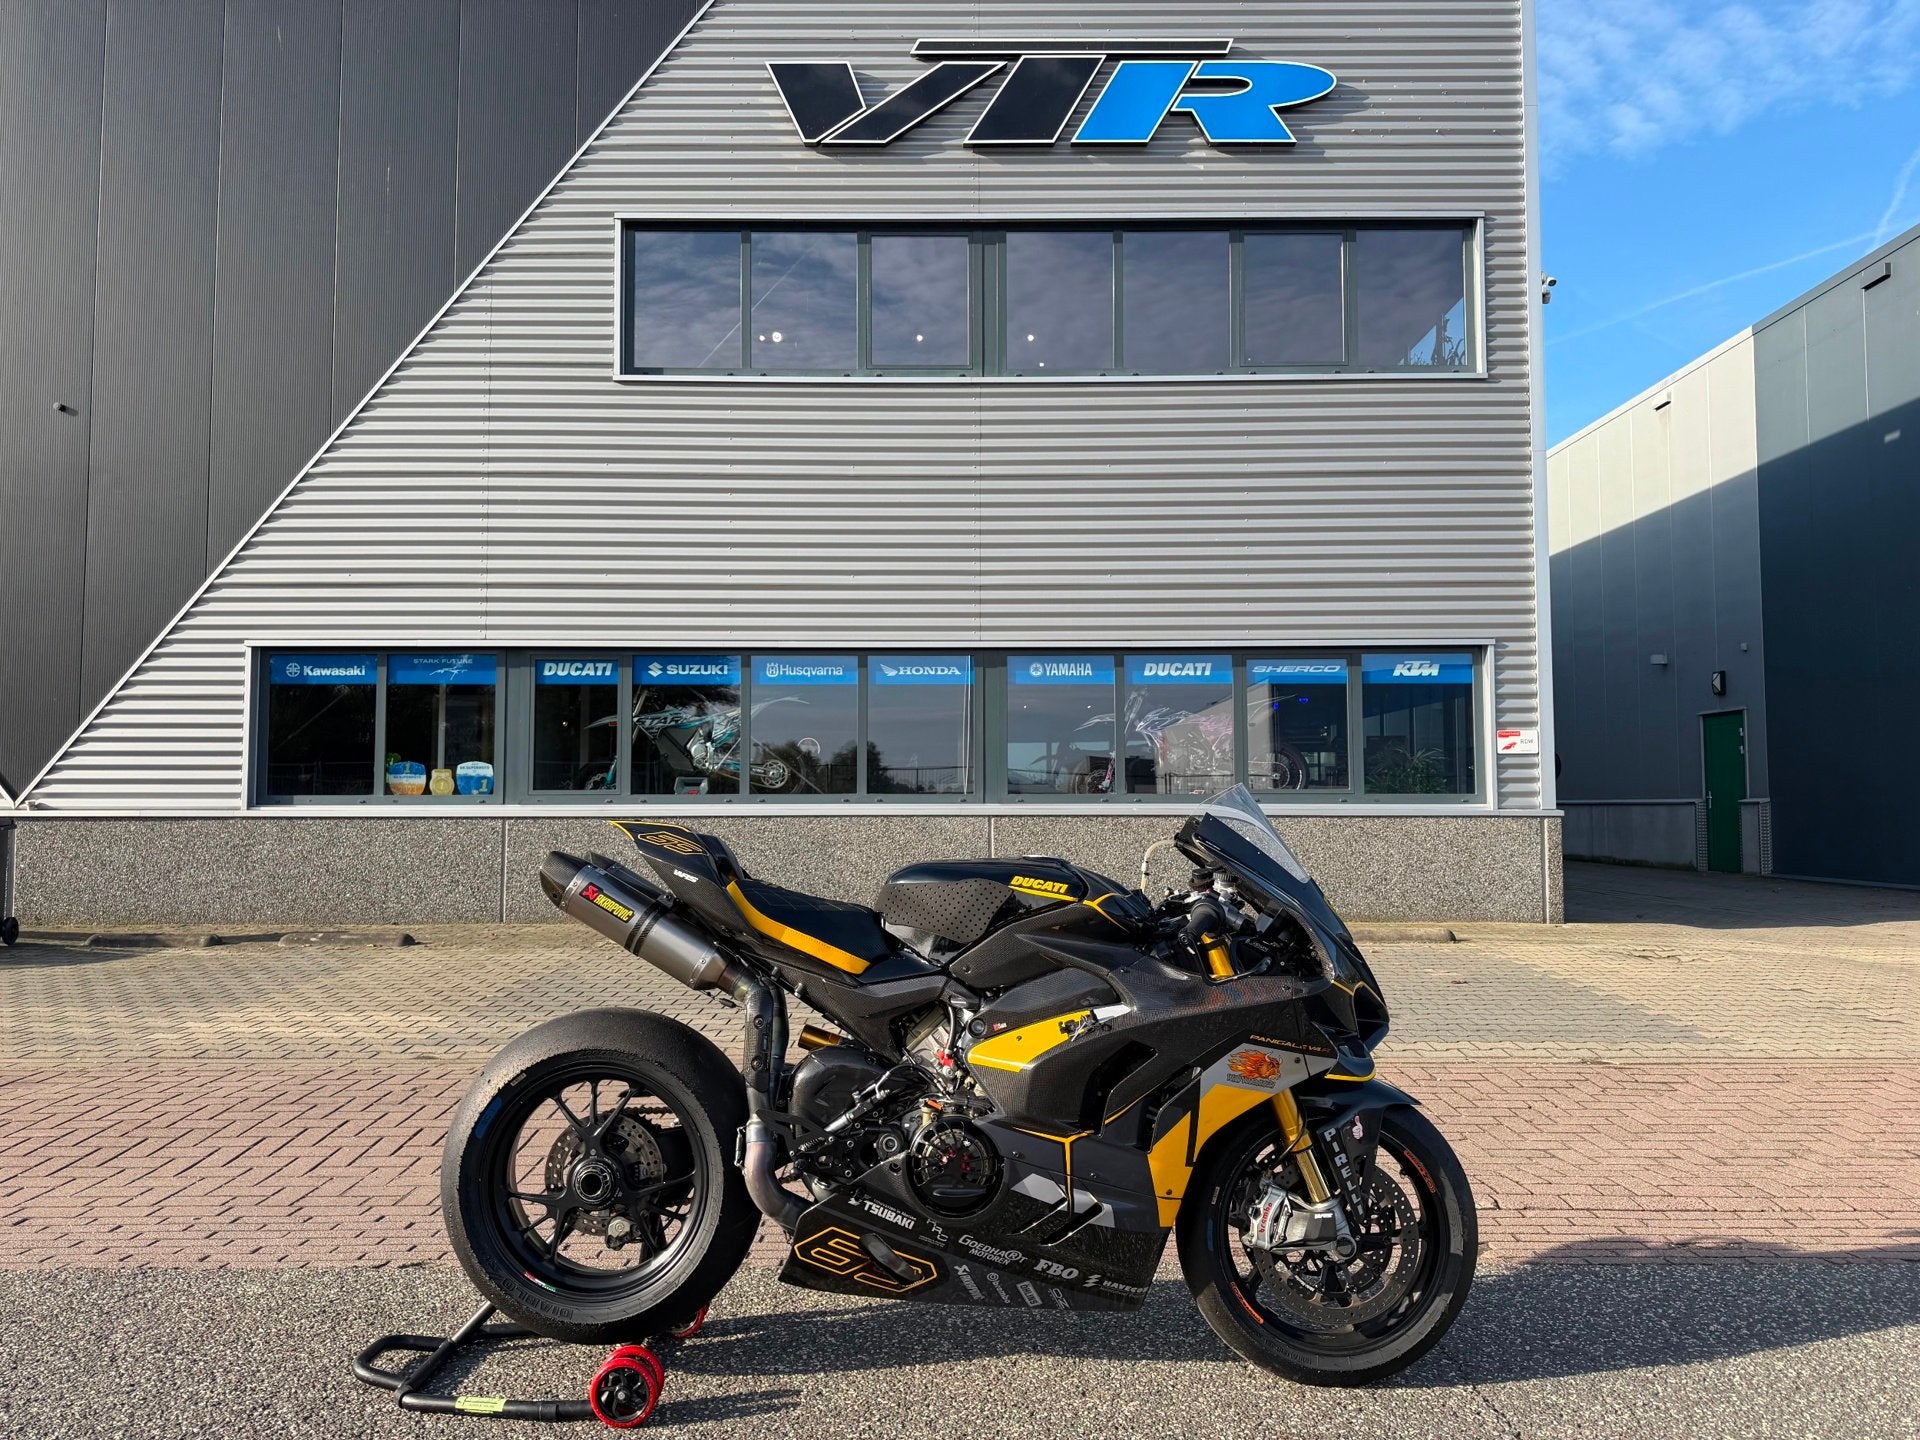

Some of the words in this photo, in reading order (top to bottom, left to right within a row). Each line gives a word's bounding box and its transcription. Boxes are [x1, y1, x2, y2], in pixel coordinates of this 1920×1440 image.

[765, 38, 1337, 147] VTR
[303, 664, 366, 677] Kawasaki
[543, 662, 612, 676] DUCATI
[666, 664, 728, 675] SUZUKI
[780, 664, 843, 678] Husqvarna
[898, 665, 960, 675] HONDA
[1044, 663, 1092, 676] YAMAHA
[1144, 662, 1212, 676] DUCATI
[1252, 665, 1341, 673] SHERCO
[1392, 660, 1439, 676] KTM
[1010, 875, 1069, 894] DUCATI
[1323, 1127, 1364, 1216] PIRELLI
[863, 1200, 915, 1230] TSUBAKI
[1259, 1202, 1273, 1234] brembo
[968, 1248, 1011, 1266] MOTOREN
[1033, 1259, 1080, 1279] FBO
